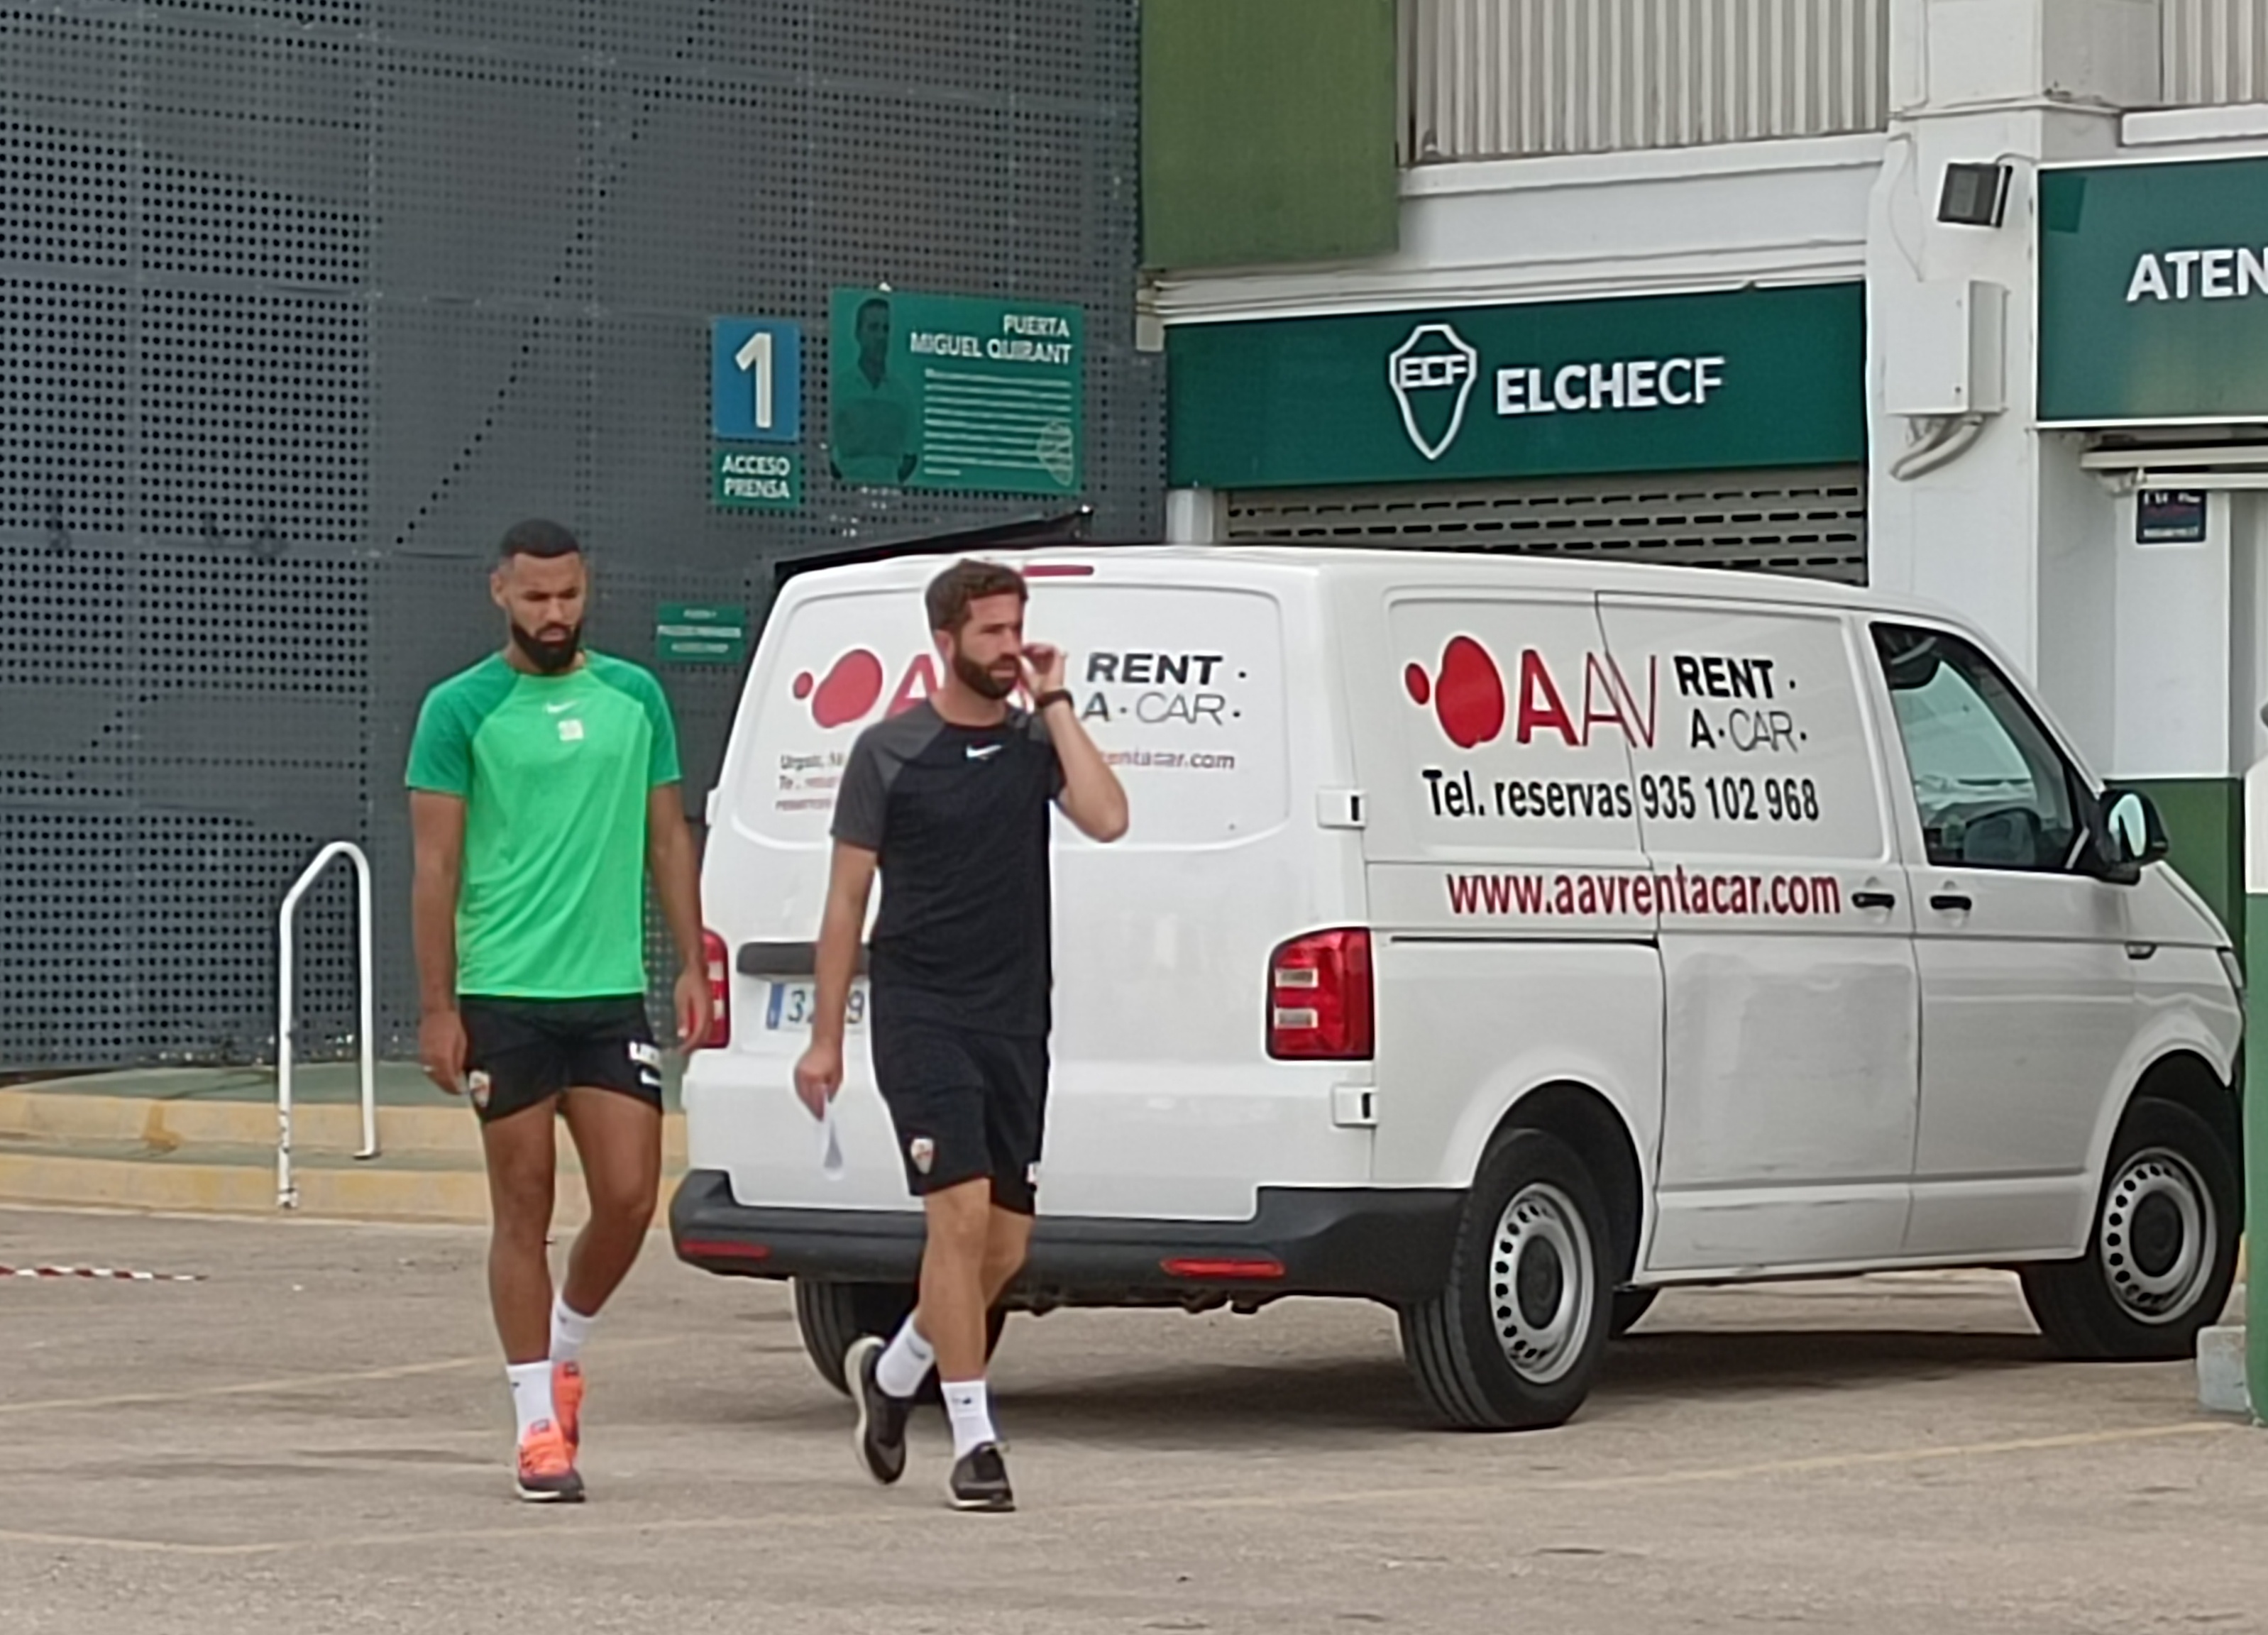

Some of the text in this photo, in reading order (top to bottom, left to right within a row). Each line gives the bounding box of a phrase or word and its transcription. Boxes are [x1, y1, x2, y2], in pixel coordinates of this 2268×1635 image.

[1003, 314, 1071, 337] PUERTA
[910, 331, 1072, 365] MIGUEL QUIRANT
[734, 331, 773, 429] 1
[1496, 356, 1726, 414] ELCHECF
[721, 455, 791, 476] ACCESO
[723, 478, 791, 499] PRENSA
[1086, 652, 1223, 686] RENT
[1673, 655, 1774, 699] RENT
[1422, 769, 1820, 820] Tel. reservas 935 102 968
[1446, 864, 1841, 915] www.aavrentacar.com
